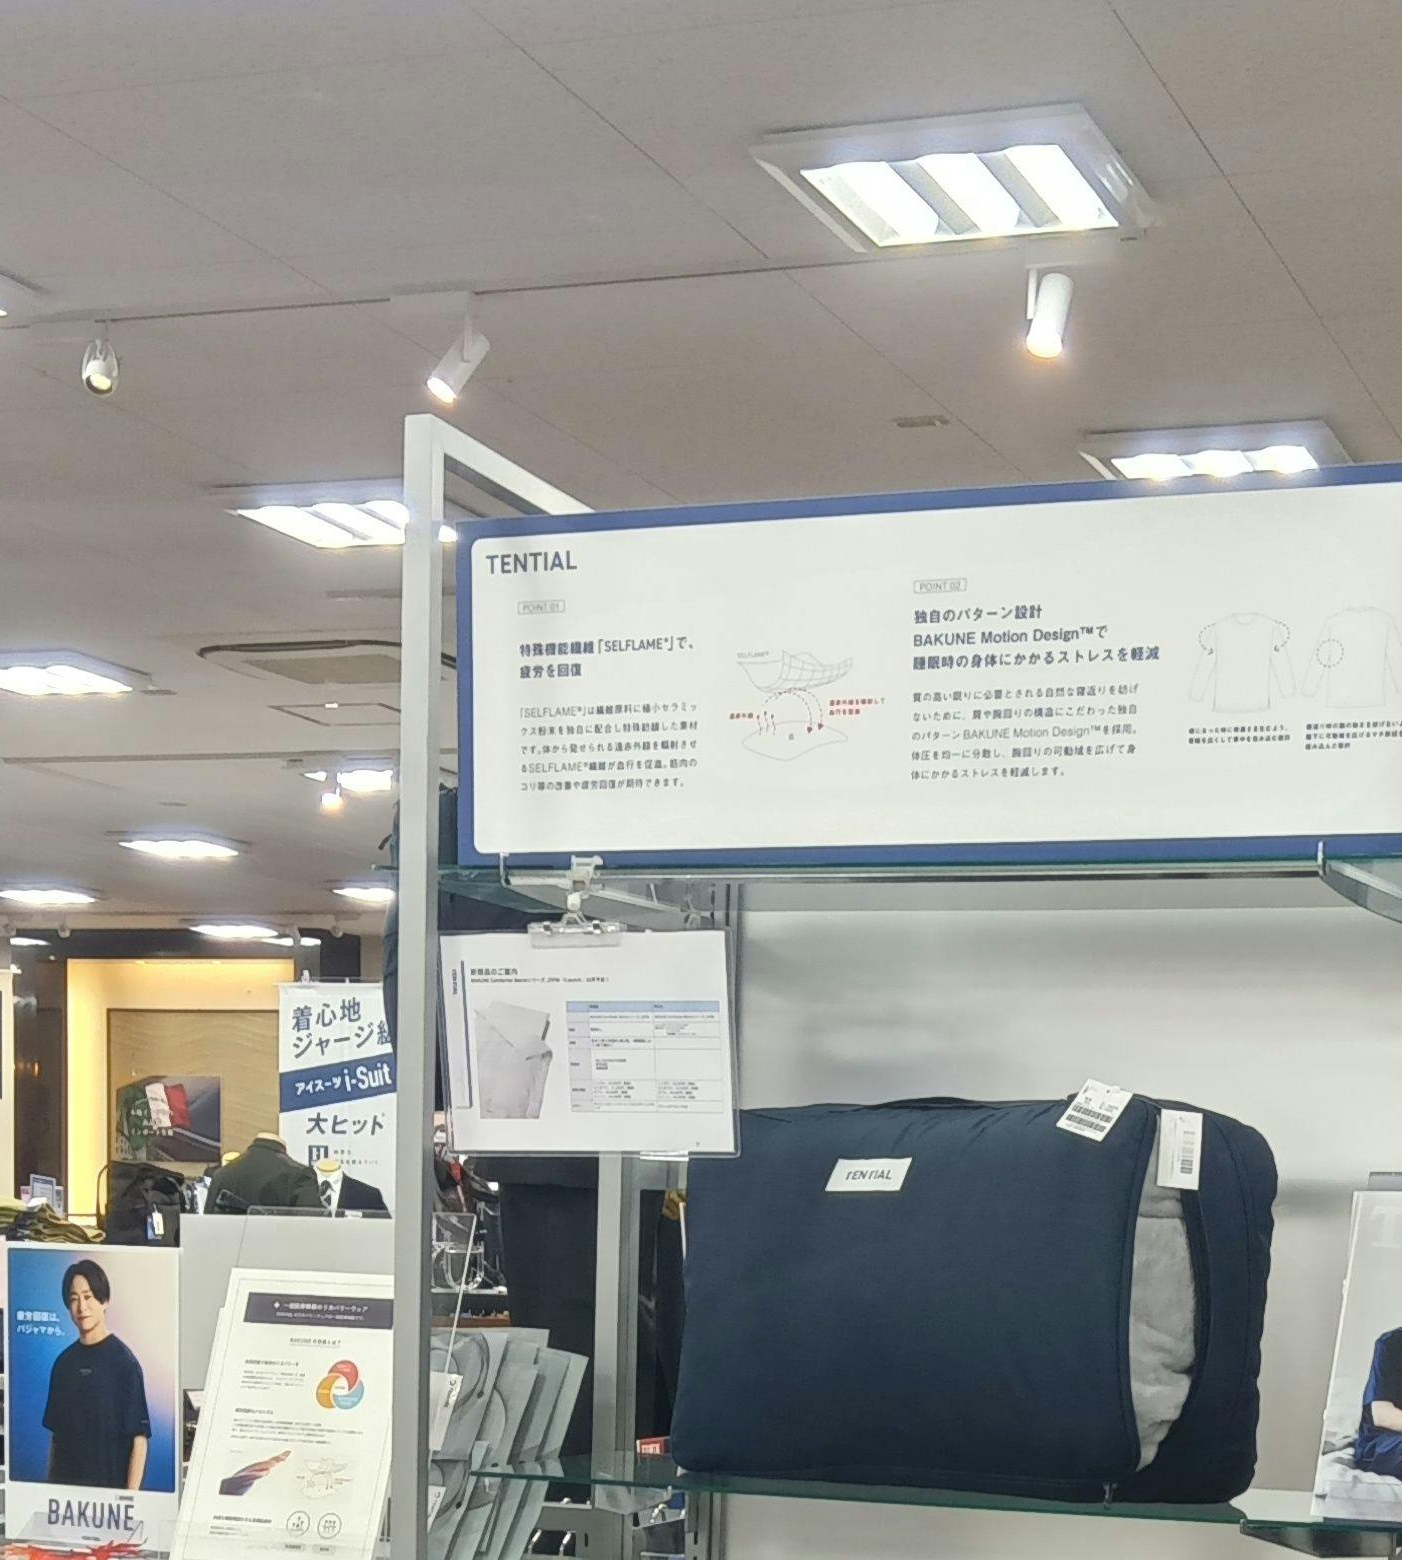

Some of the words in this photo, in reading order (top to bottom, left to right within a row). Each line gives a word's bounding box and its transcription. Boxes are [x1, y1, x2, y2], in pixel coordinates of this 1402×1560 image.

[486, 550, 578, 575] TENTIAL
[914, 604, 1042, 624] 独自のパターン設計
[913, 631, 976, 647] BAKUNE
[980, 629, 1028, 645] Motion
[913, 646, 1161, 671] 睡眠時の身体にかかるストレスを軽減
[519, 663, 582, 679] 疲労を回復
[911, 731, 960, 742] のパターン
[963, 728, 1011, 741] BAKUNE
[1013, 727, 1049, 739] Motion
[292, 997, 361, 1032] 着心地
[295, 1075, 341, 1096] アイスーツ
[343, 1063, 392, 1093] i-Suit
[306, 1112, 384, 1136] 大ヒット
[845, 1167, 892, 1182] TENTIAL
[16, 1310, 60, 1322] 疲労回復は、
[16, 1325, 65, 1336] パジャマから。
[47, 1498, 135, 1532] BAKUNE
